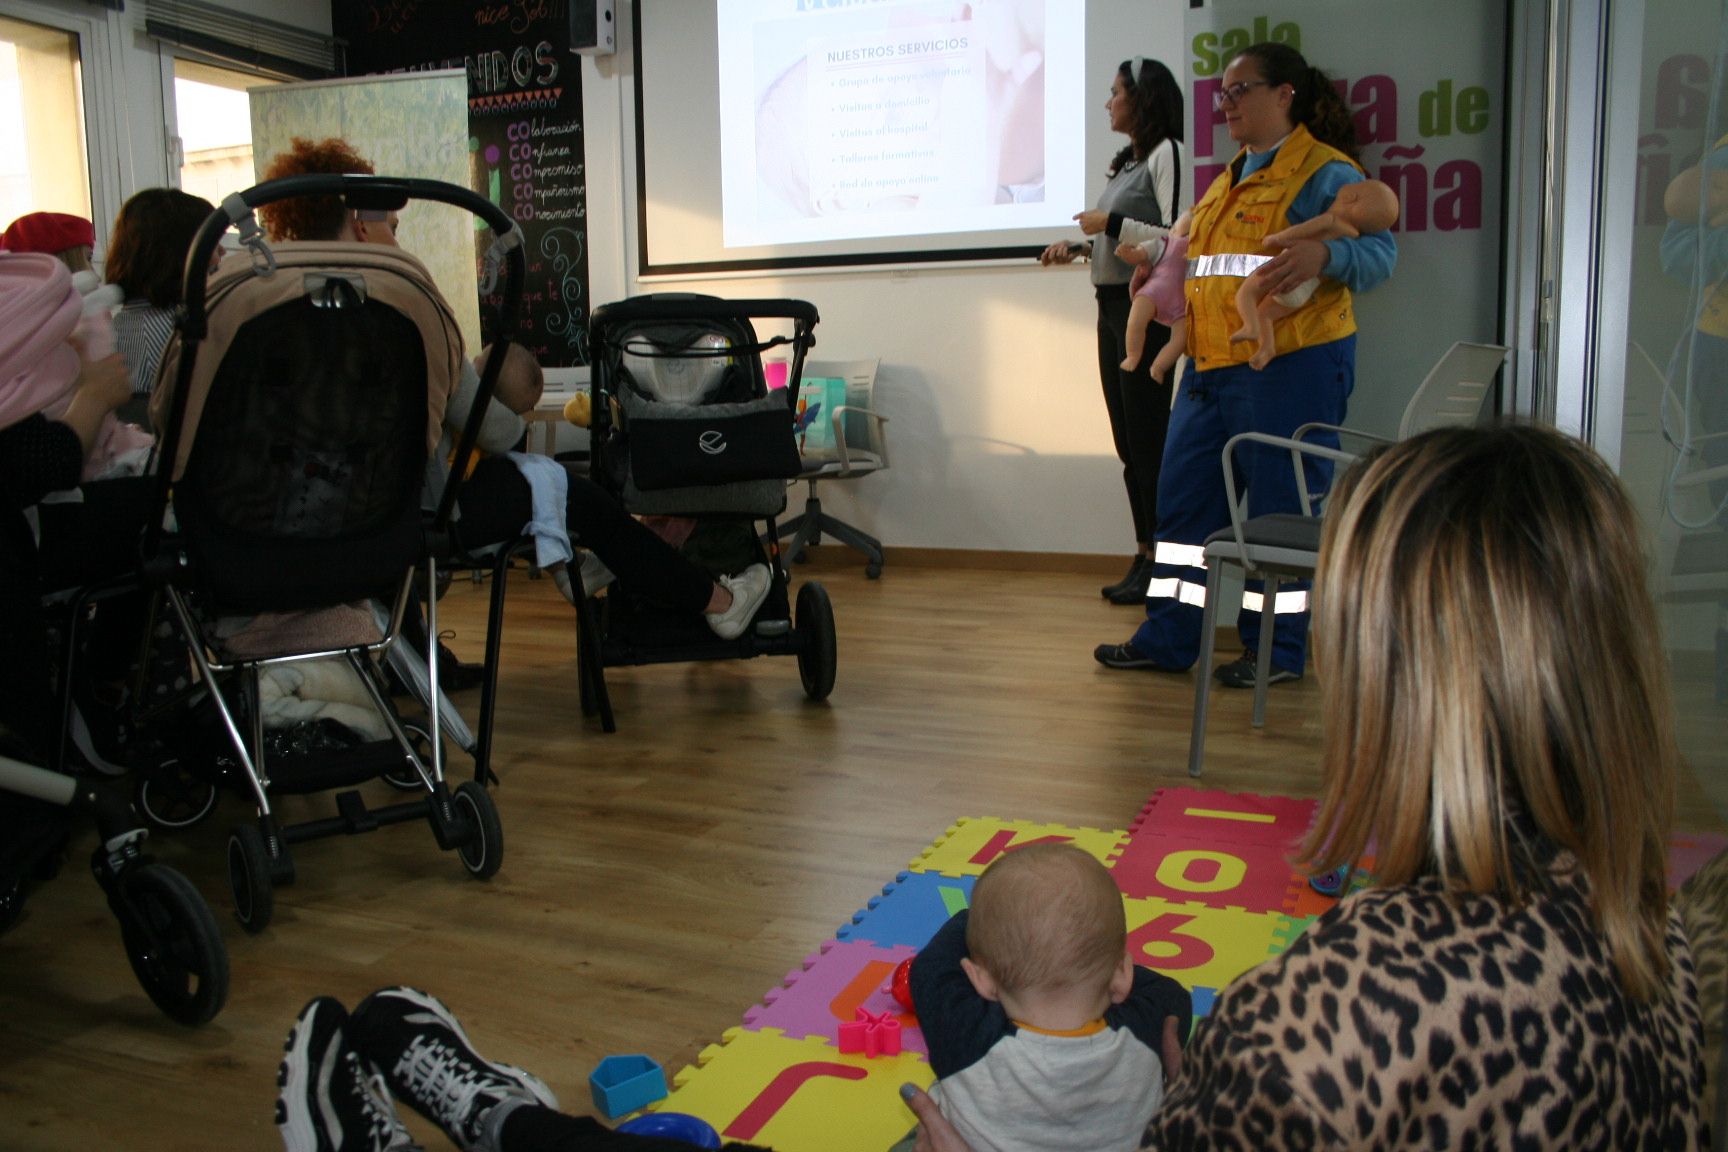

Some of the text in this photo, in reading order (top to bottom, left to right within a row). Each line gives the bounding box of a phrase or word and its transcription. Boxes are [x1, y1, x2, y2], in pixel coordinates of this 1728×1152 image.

[827, 37, 968, 63] NUESTROS SERVICIOS
[1418, 79, 1490, 137] de
